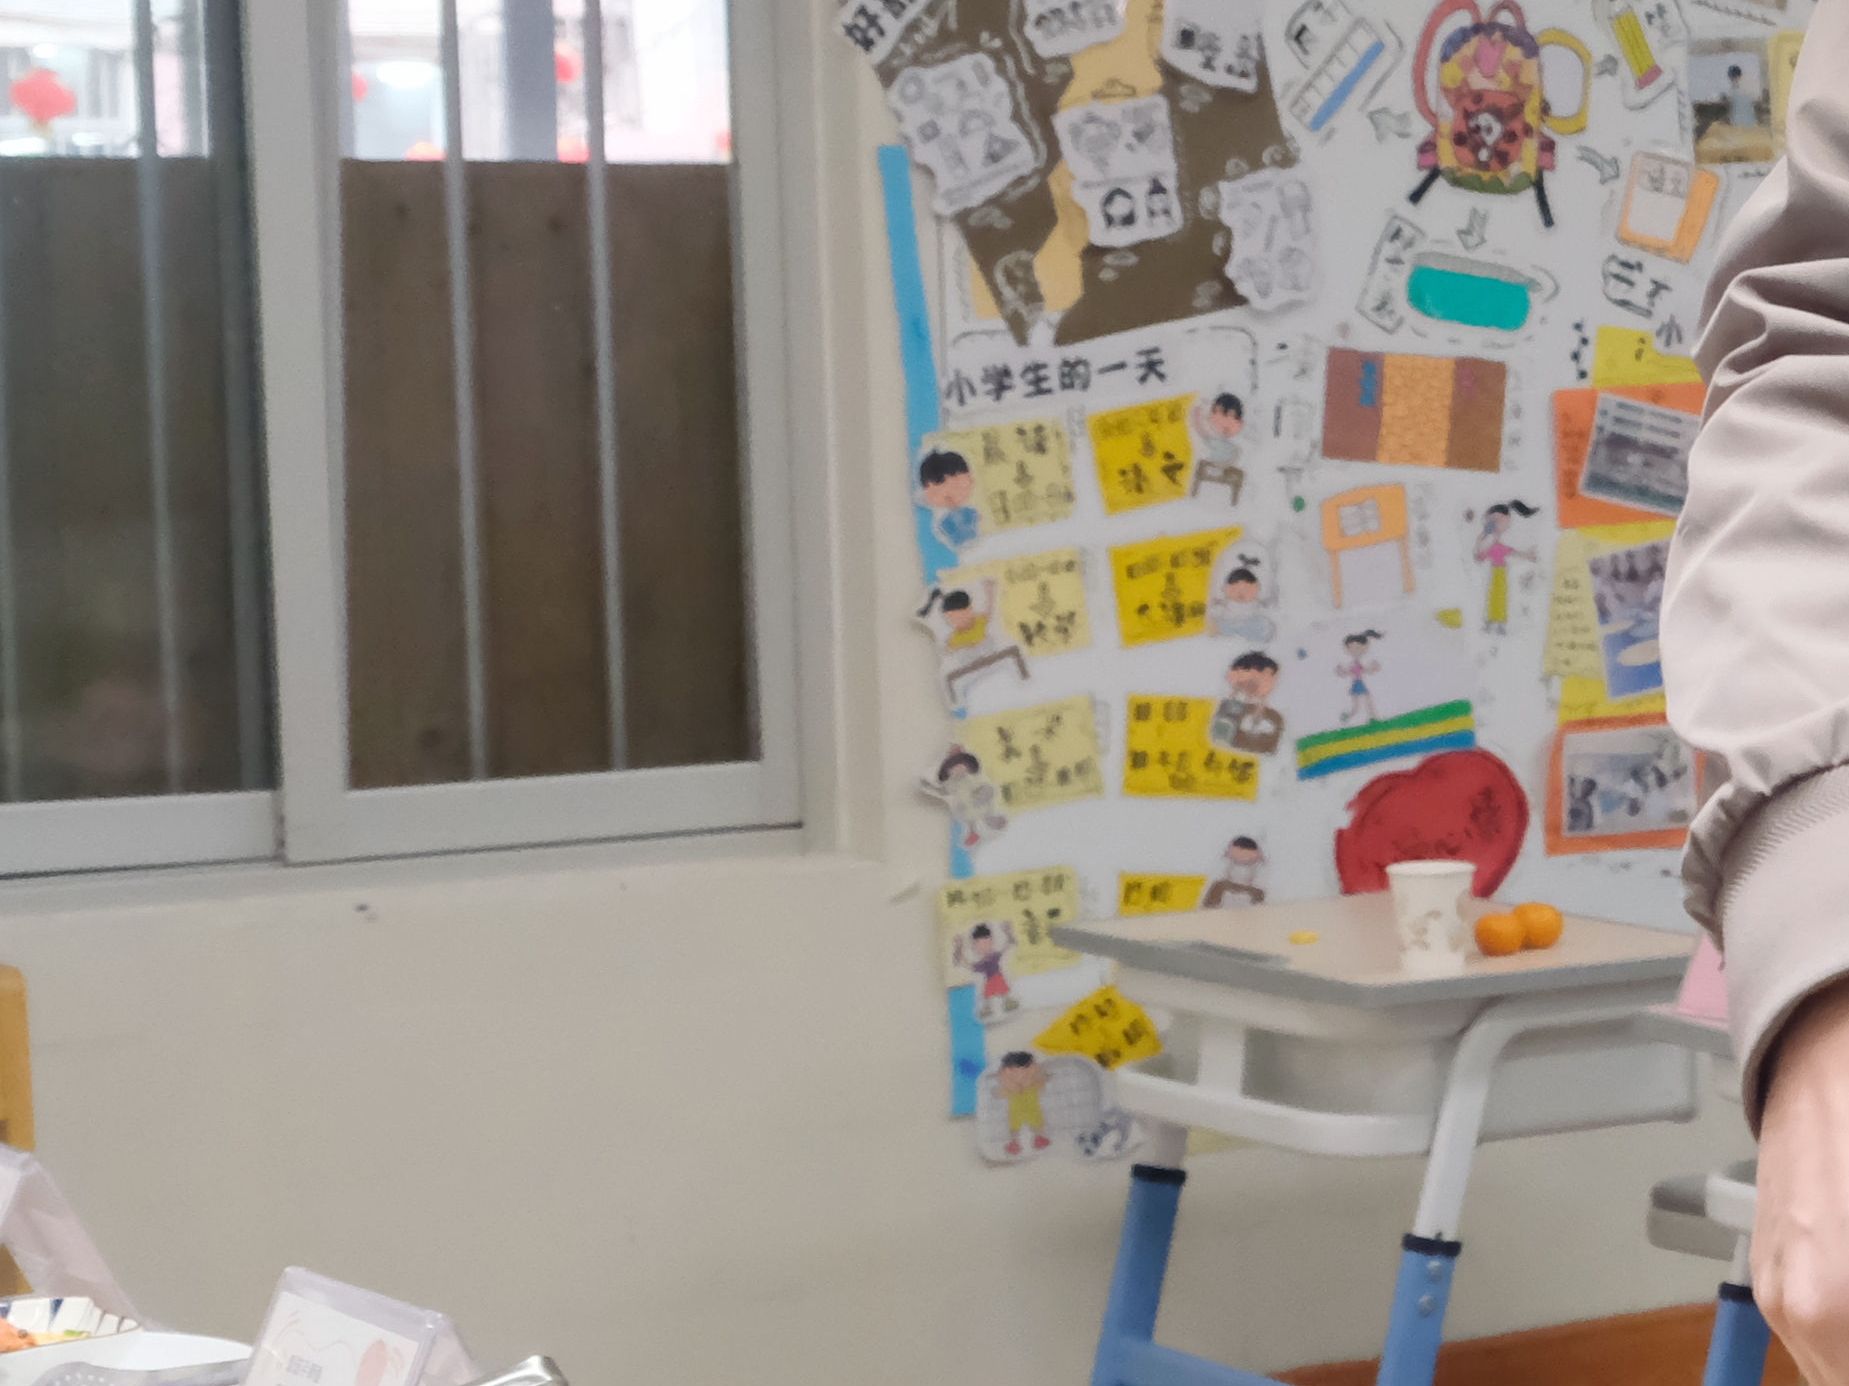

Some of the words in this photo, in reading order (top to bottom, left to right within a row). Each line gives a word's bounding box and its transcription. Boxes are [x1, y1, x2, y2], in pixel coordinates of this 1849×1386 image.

[946, 347, 1167, 407] 小学生的一天
